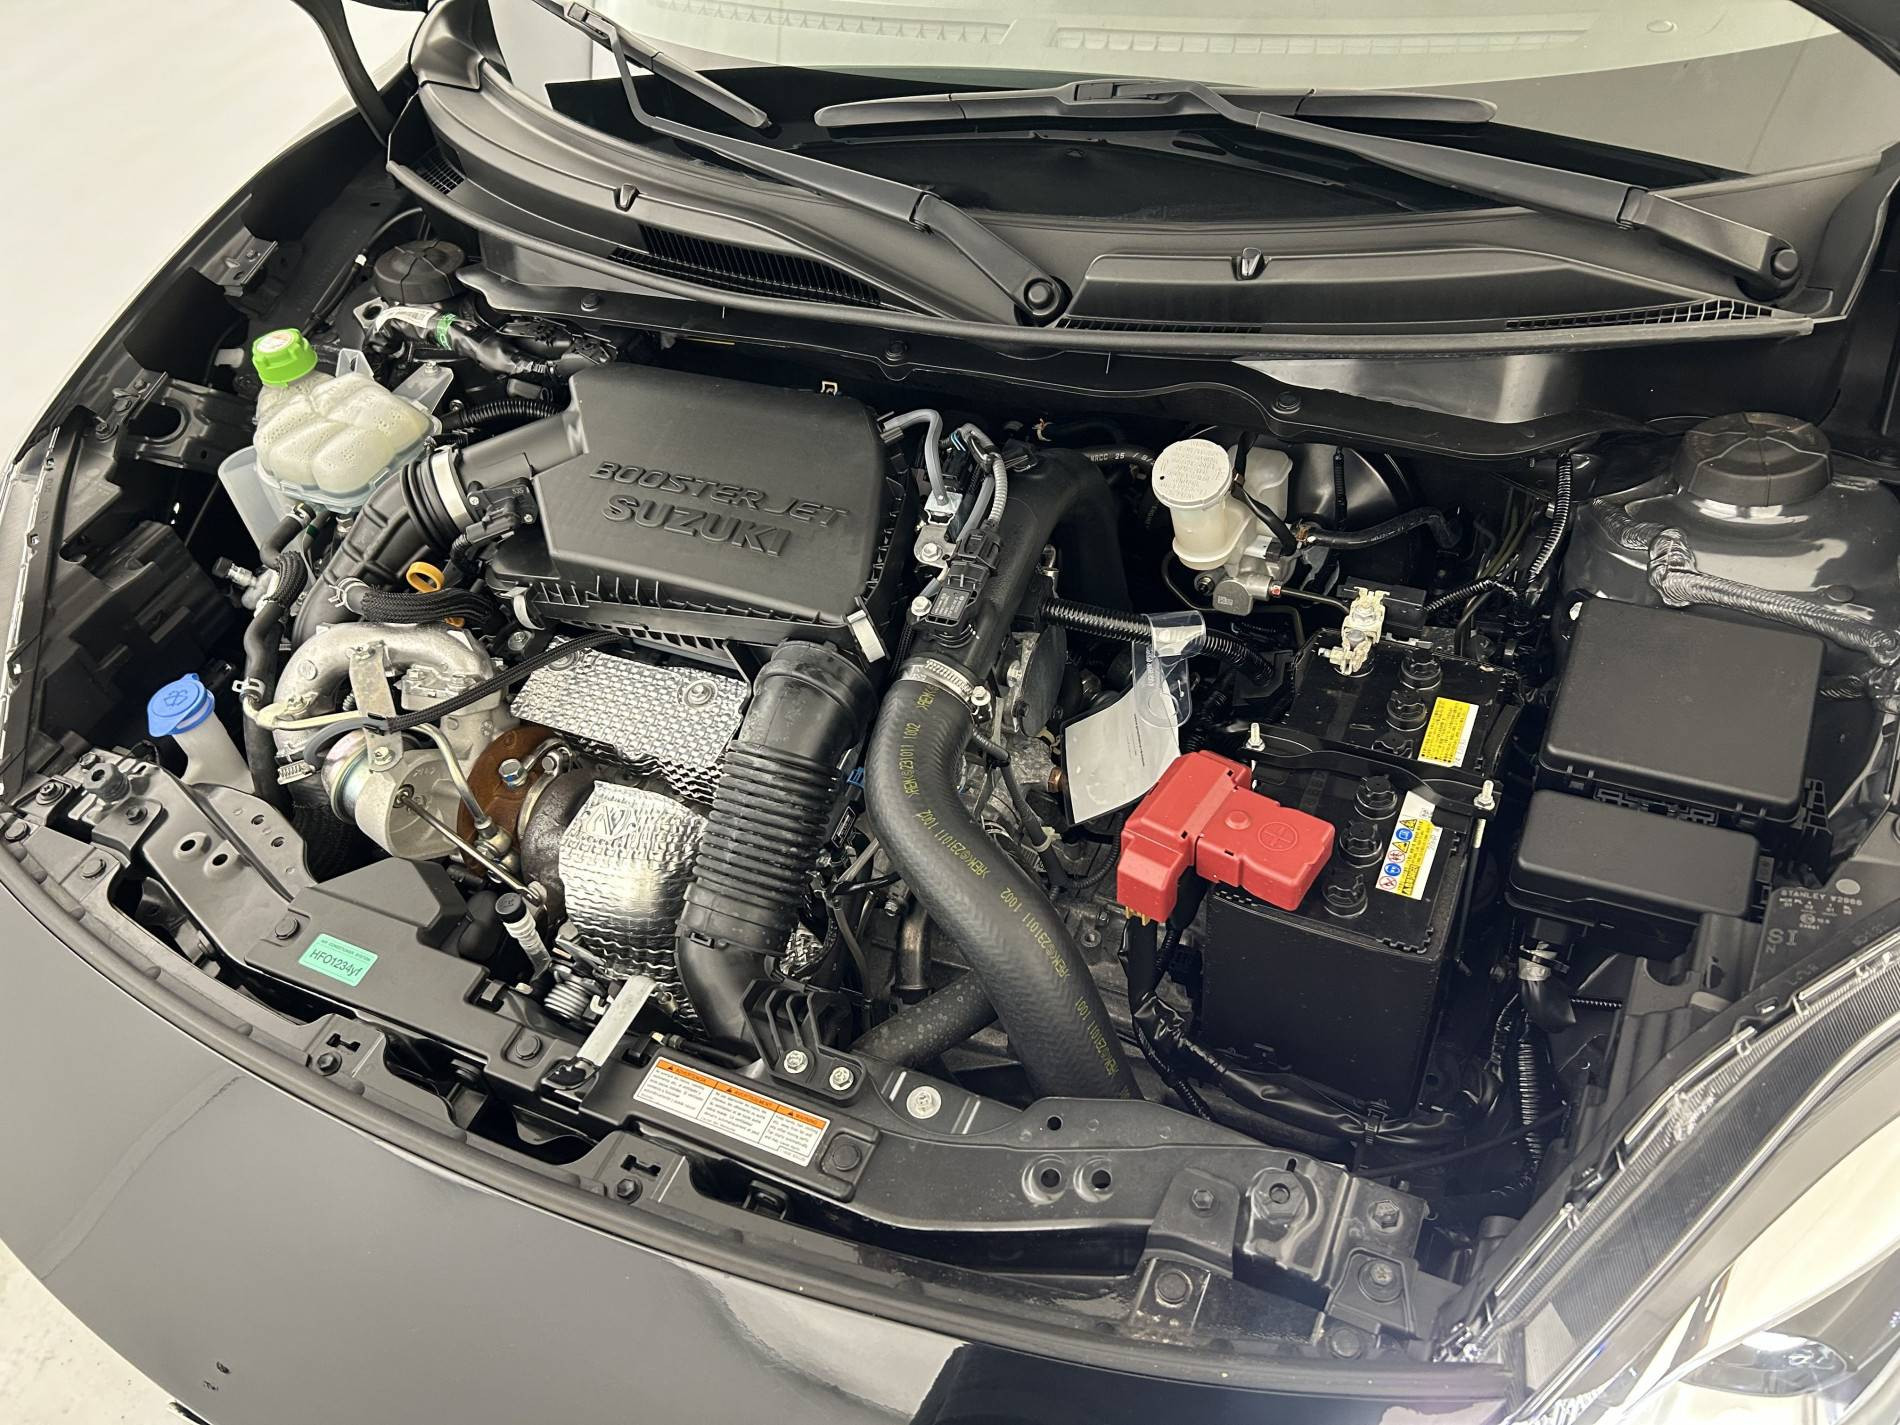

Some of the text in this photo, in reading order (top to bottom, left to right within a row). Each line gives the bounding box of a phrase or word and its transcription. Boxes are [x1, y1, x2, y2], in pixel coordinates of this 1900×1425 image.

[589, 460, 850, 528] BOOSTER JET
[601, 494, 792, 557] SUZUKI
[903, 722, 921, 740] 1002
[1000, 887, 1023, 913] 1002
[1780, 888, 1826, 900] STANLEY
[308, 948, 364, 977] HFO1234yf
